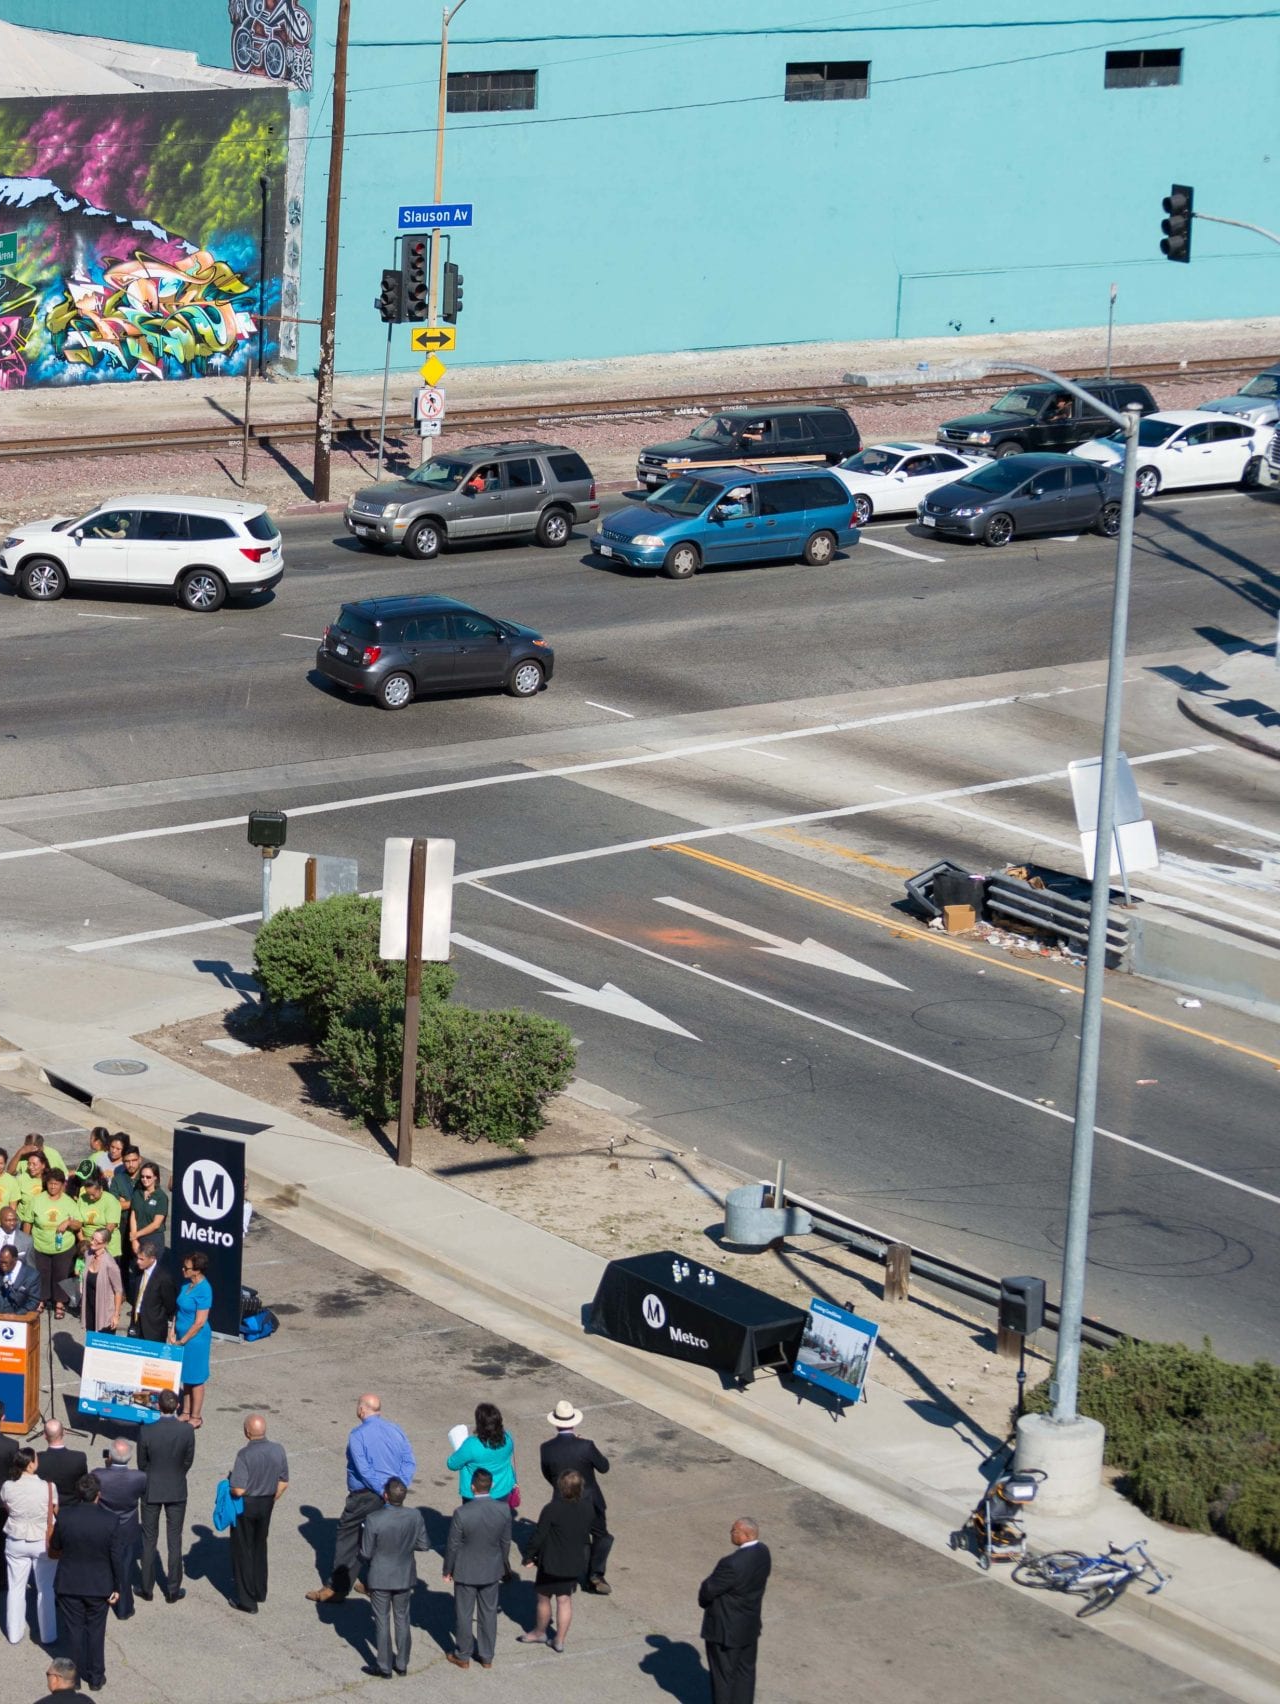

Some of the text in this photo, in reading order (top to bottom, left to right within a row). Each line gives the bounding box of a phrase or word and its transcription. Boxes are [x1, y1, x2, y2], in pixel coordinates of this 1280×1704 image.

[403, 208, 468, 223] Slauson Av
[193, 1169, 224, 1210] M
[181, 1219, 234, 1247] Metro
[669, 1326, 709, 1349] Metro
